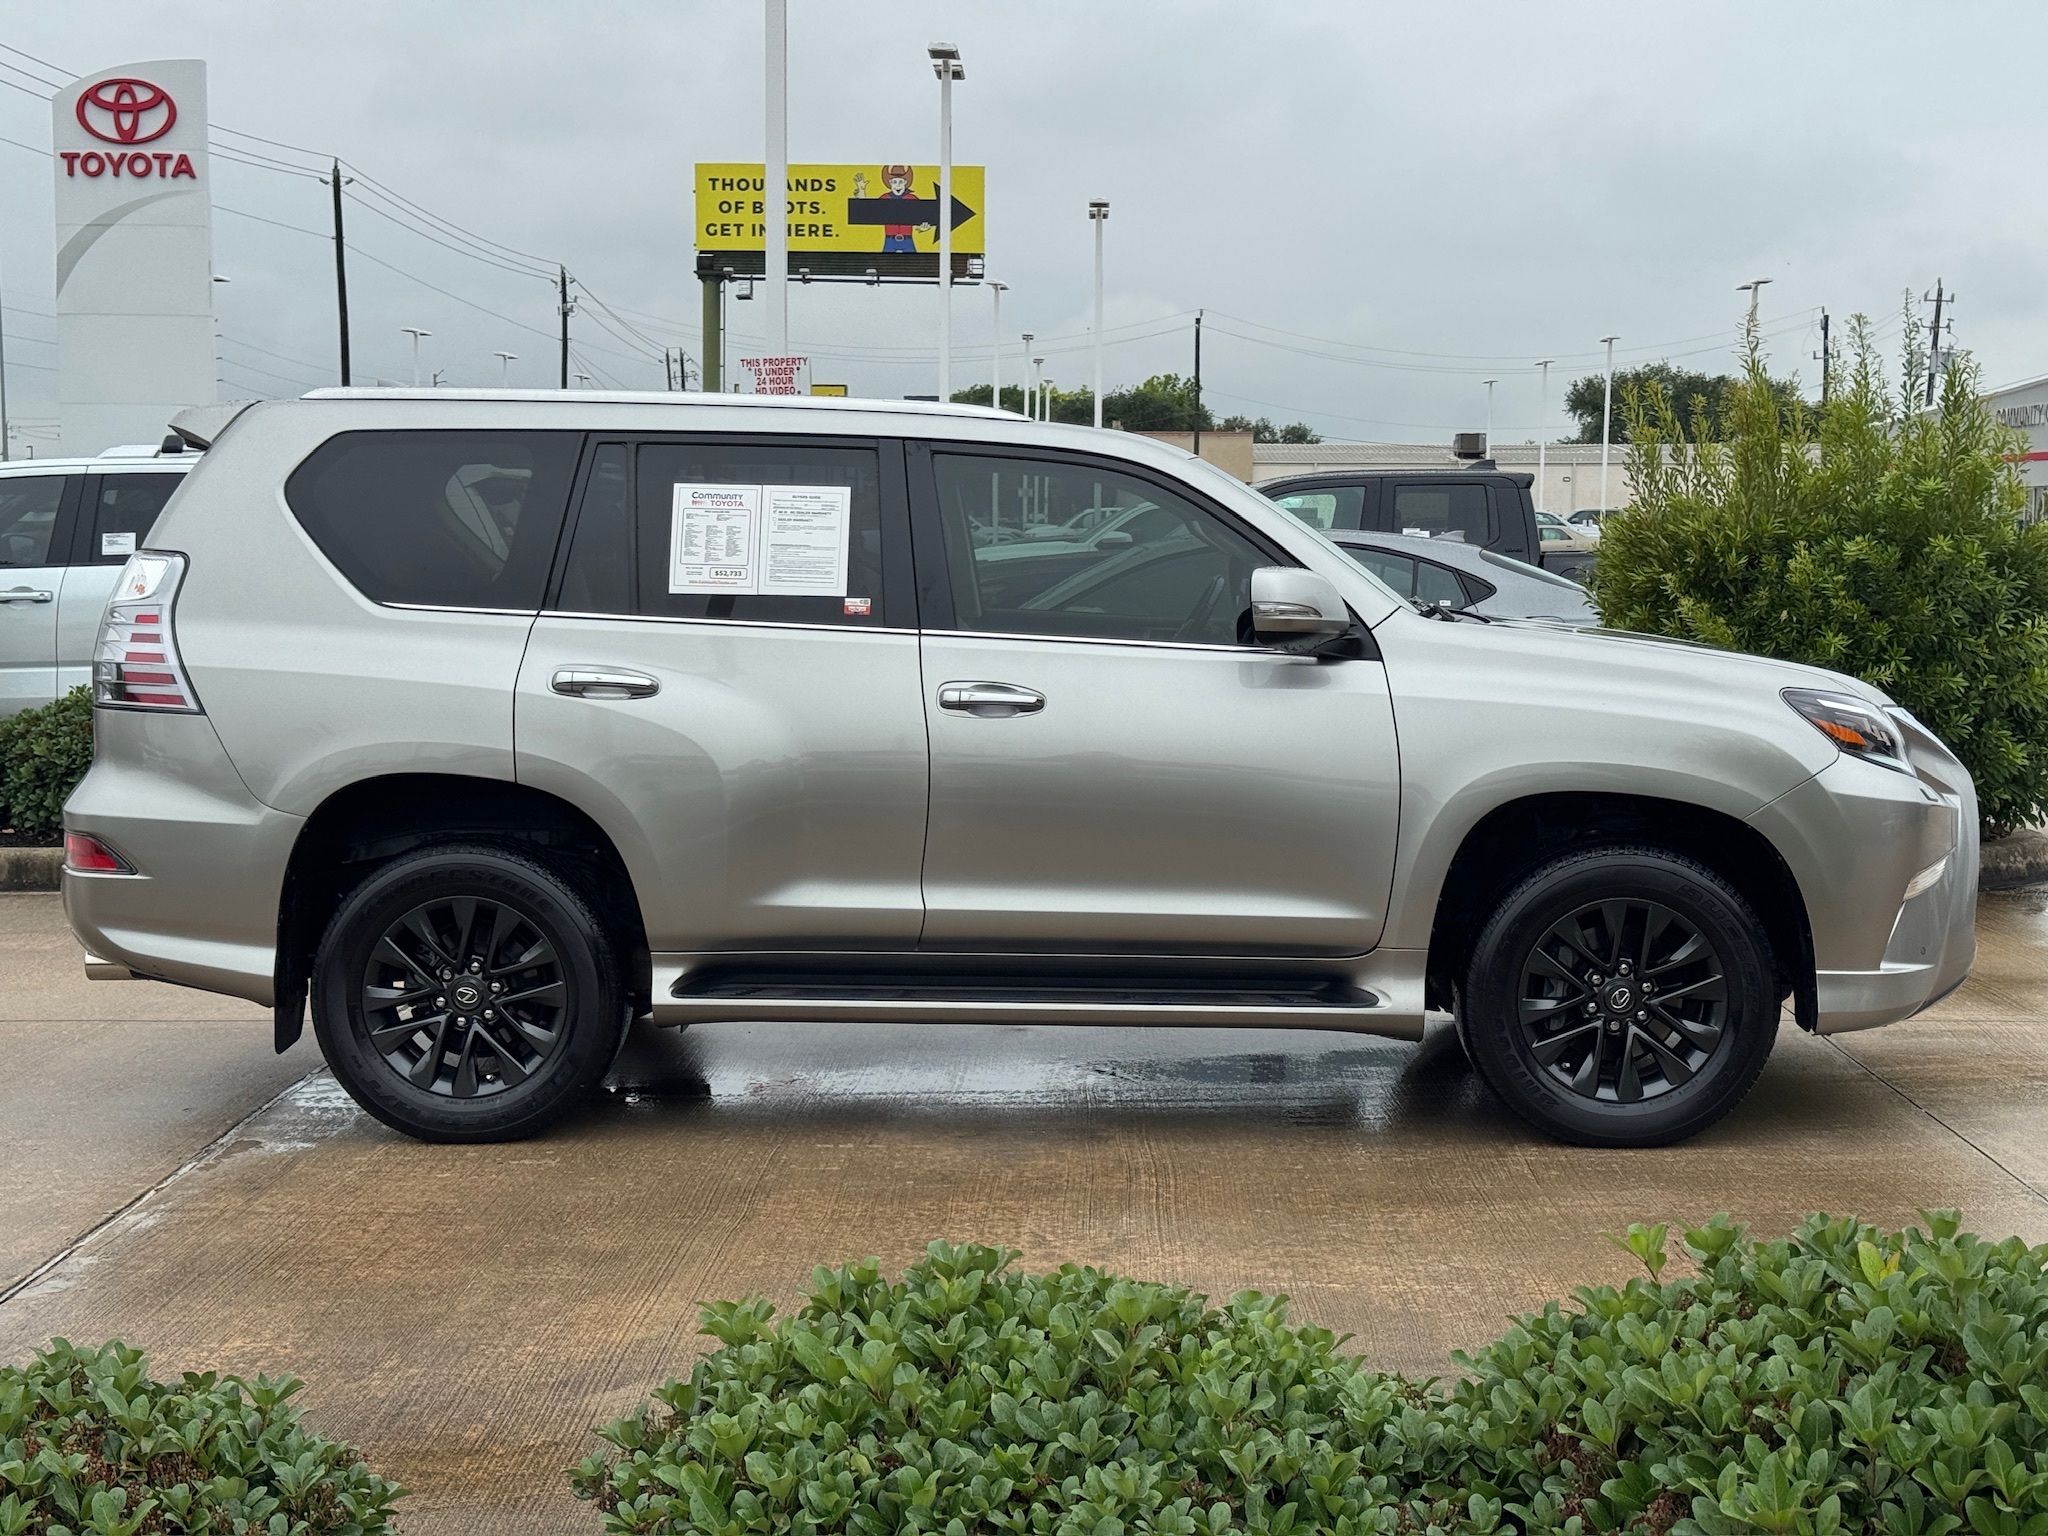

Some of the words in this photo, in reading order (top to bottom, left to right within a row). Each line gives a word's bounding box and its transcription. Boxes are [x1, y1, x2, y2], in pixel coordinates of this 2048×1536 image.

[60, 152, 196, 179] TOYOTA
[718, 201, 745, 214] OF
[705, 223, 744, 236] GET
[787, 224, 839, 237] ERE.
[740, 359, 760, 367] THIS
[763, 357, 808, 367] PROPERTY
[754, 368, 763, 376] IS
[765, 367, 795, 376] UNDER
[756, 377, 766, 386] 24
[769, 377, 794, 386] HOUR
[770, 386, 796, 395] VIDEO
